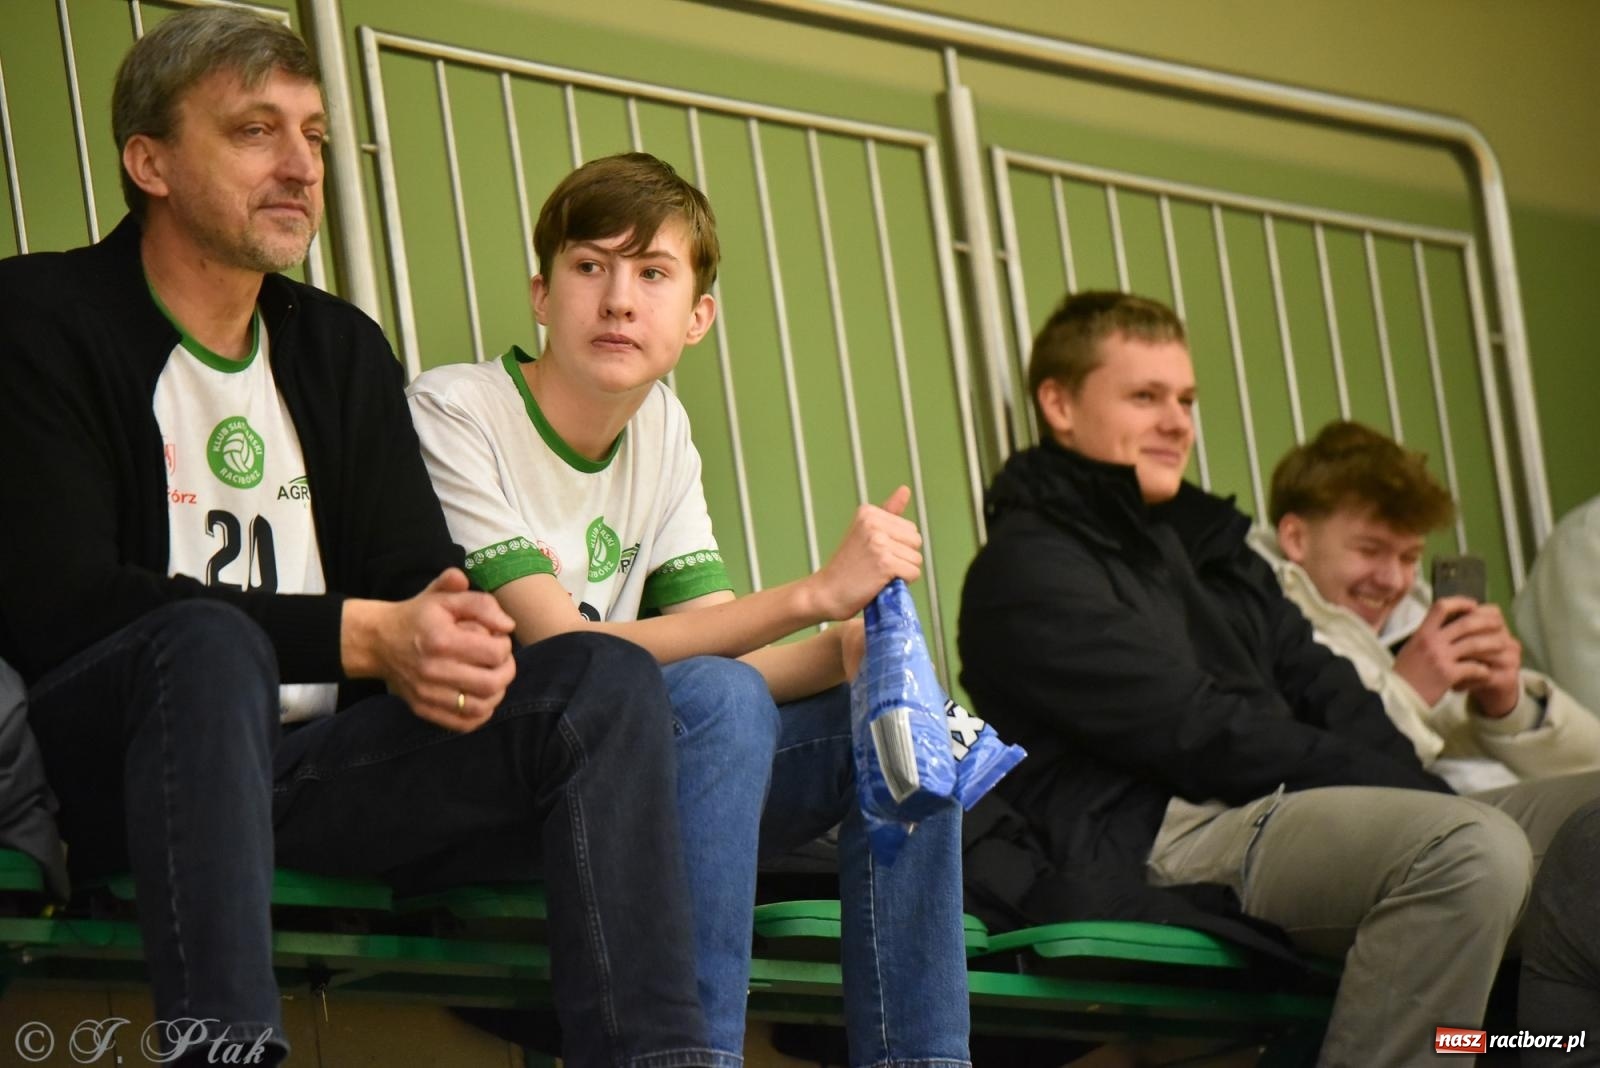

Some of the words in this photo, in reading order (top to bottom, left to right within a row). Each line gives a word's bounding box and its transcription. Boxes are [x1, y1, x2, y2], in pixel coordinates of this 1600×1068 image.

[212, 427, 229, 452] KLUB
[167, 489, 197, 504] órz
[277, 485, 310, 500] AGR
